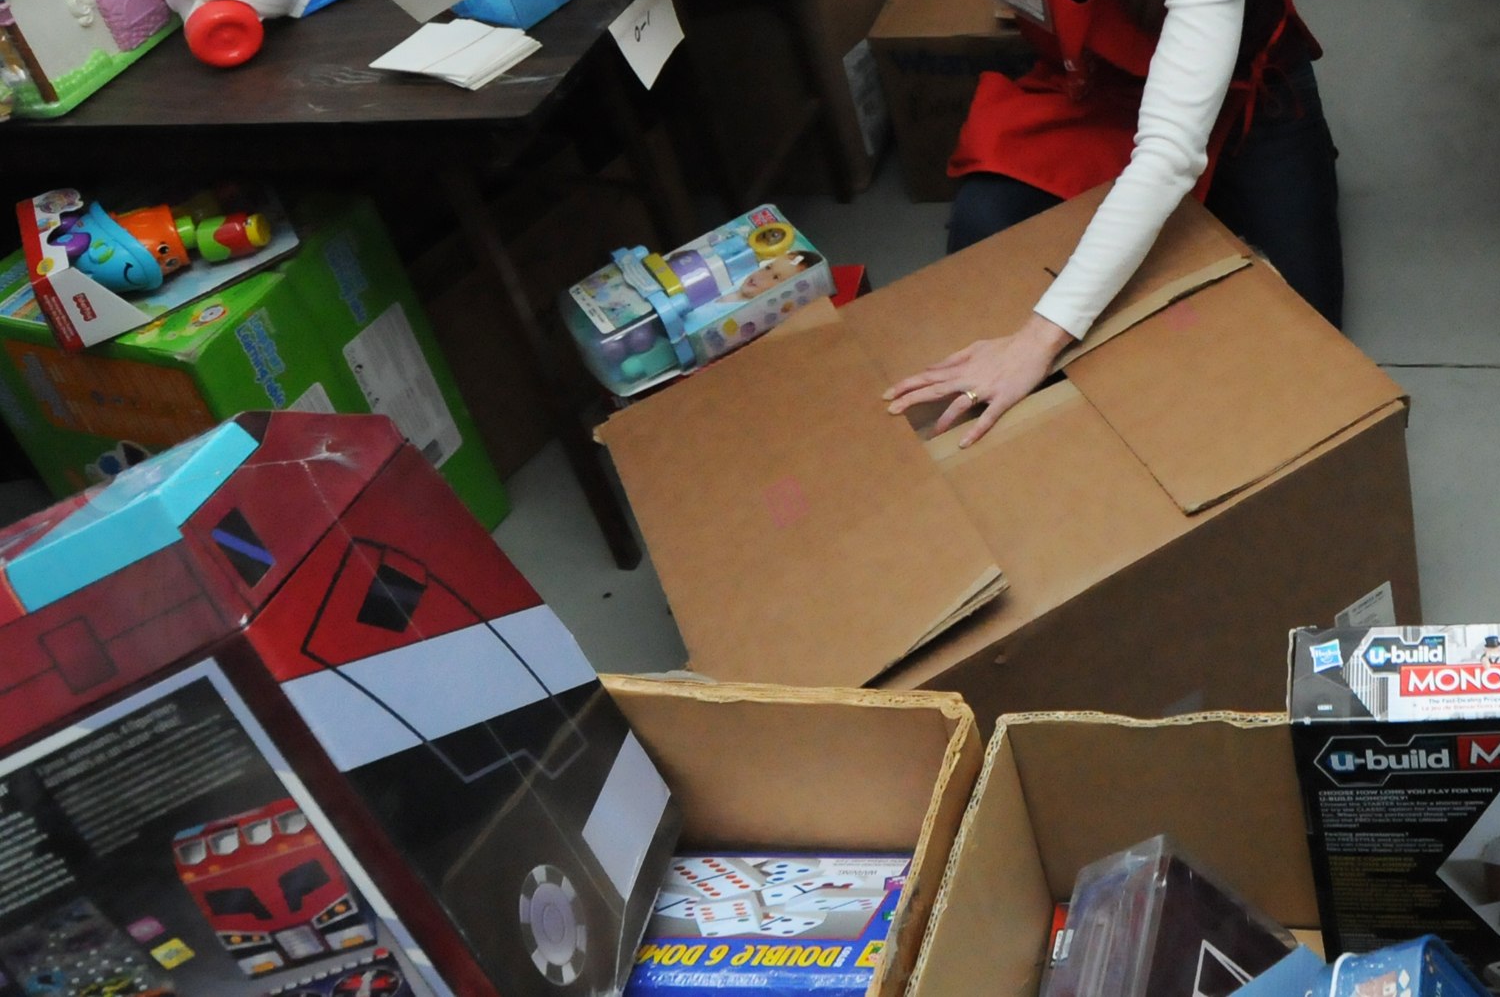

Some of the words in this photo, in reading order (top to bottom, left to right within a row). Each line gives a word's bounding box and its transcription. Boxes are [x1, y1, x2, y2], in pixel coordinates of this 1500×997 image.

[1368, 643, 1443, 666] u-build
[1328, 746, 1451, 772] u-build
[704, 944, 731, 967] 6
[731, 944, 838, 968] DOUBLE
